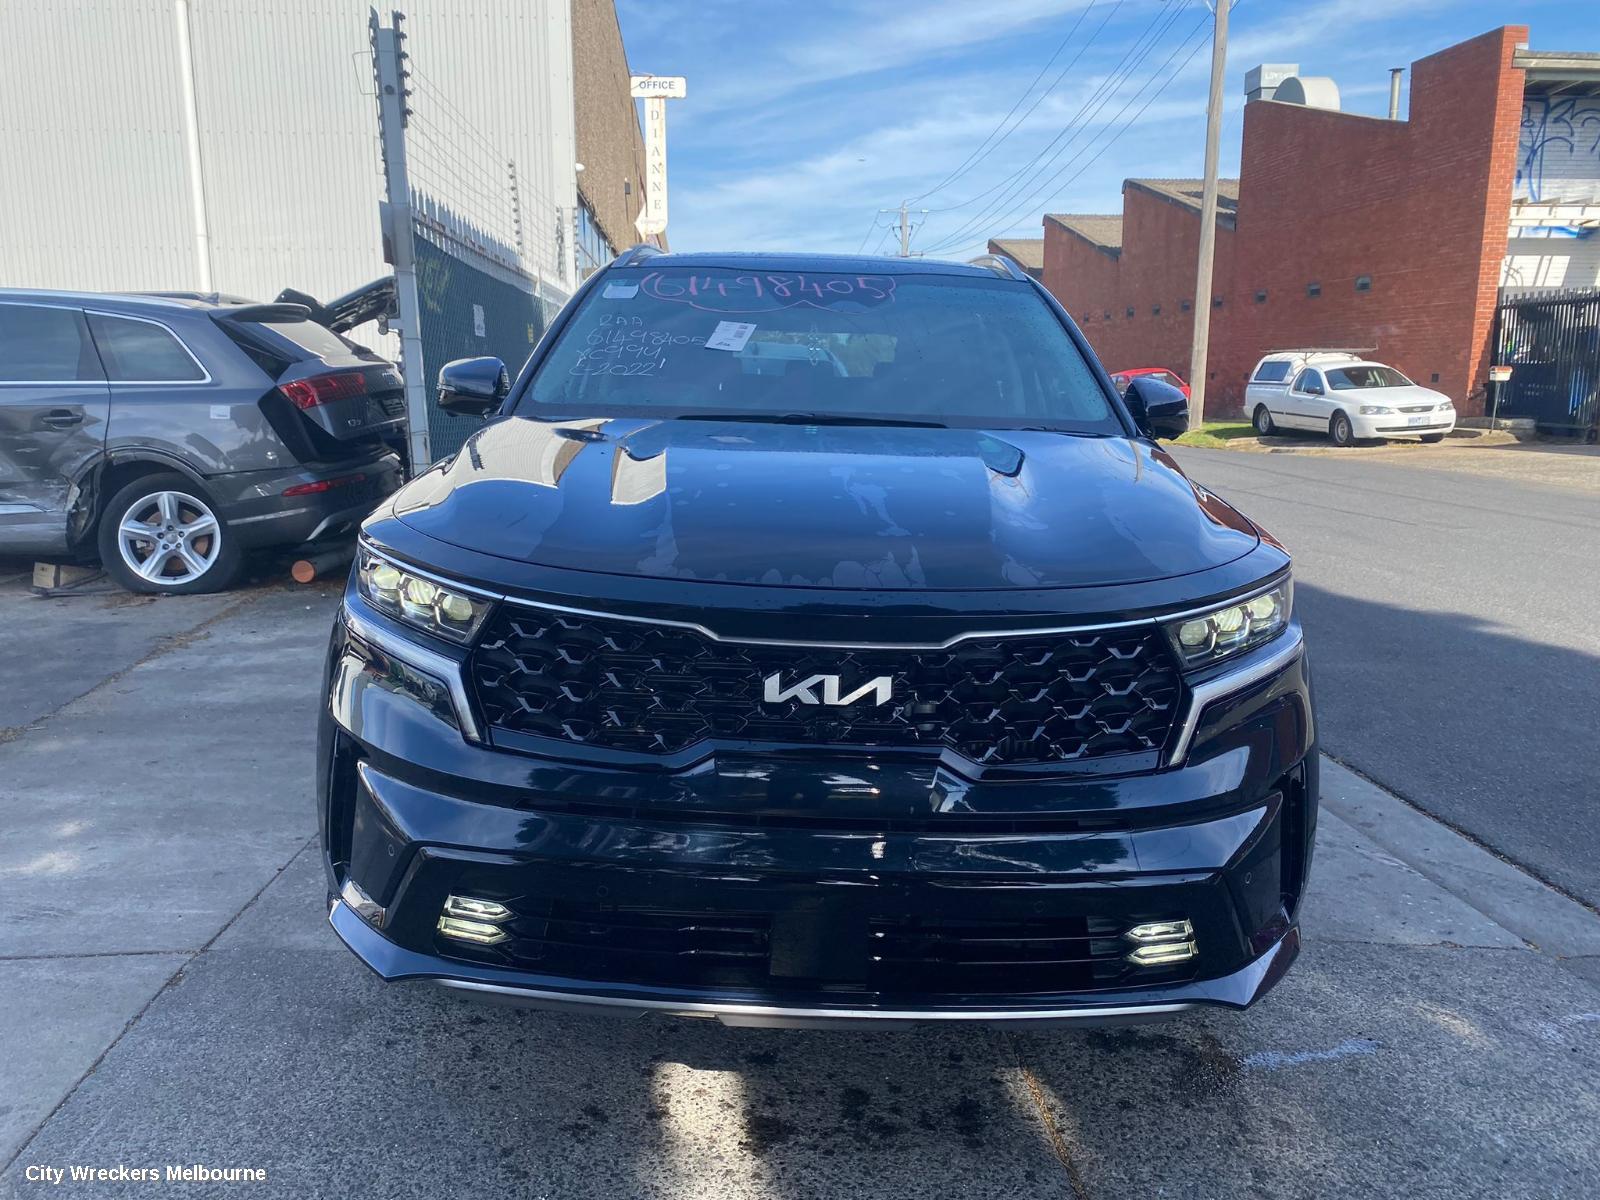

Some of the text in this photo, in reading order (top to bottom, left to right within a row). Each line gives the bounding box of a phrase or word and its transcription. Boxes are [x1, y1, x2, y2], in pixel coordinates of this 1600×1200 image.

[638, 80, 676, 90] OFFICE
[650, 110, 664, 210] DIANNE
[764, 673, 892, 706] KIA
